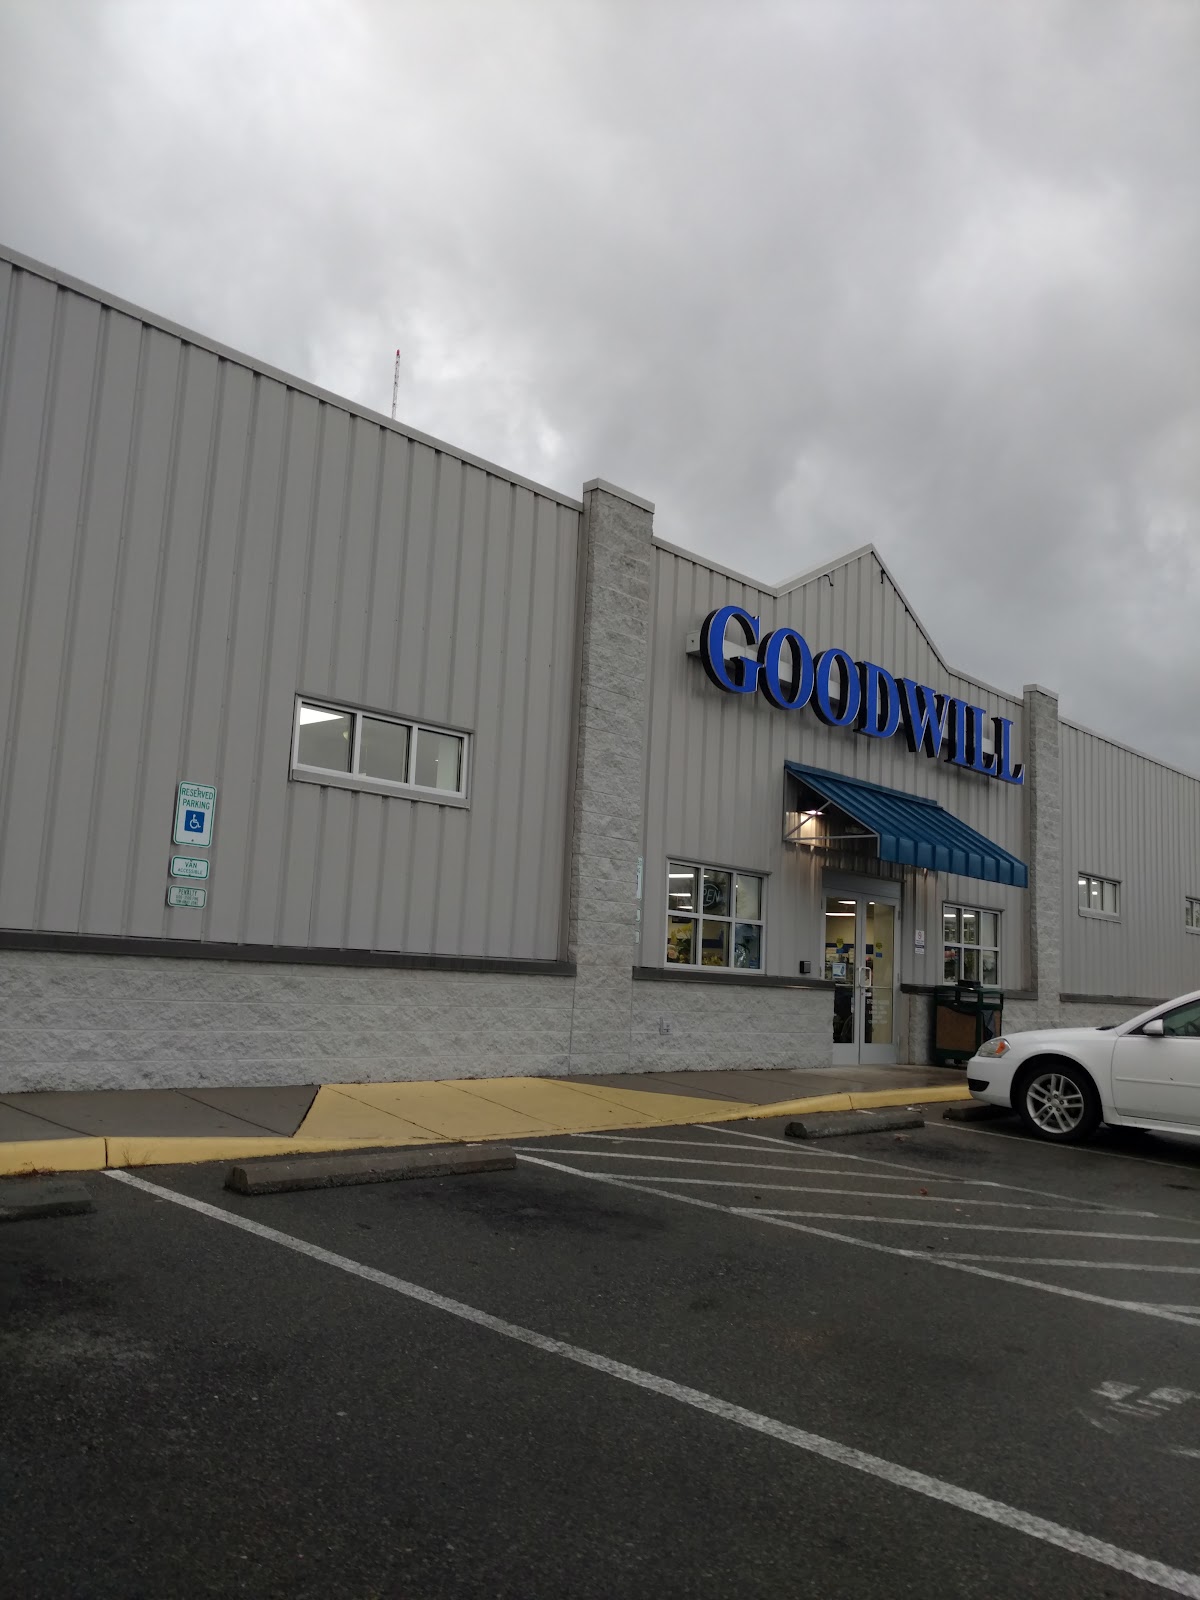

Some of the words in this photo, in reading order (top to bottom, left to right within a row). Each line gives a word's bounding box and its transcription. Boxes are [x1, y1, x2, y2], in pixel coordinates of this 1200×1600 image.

[700, 605, 1025, 785] GOODWILL
[181, 787, 213, 800] RESERVED
[182, 798, 210, 810] PARKING
[184, 861, 198, 869] VAN
[702, 888, 721, 903] PEN
